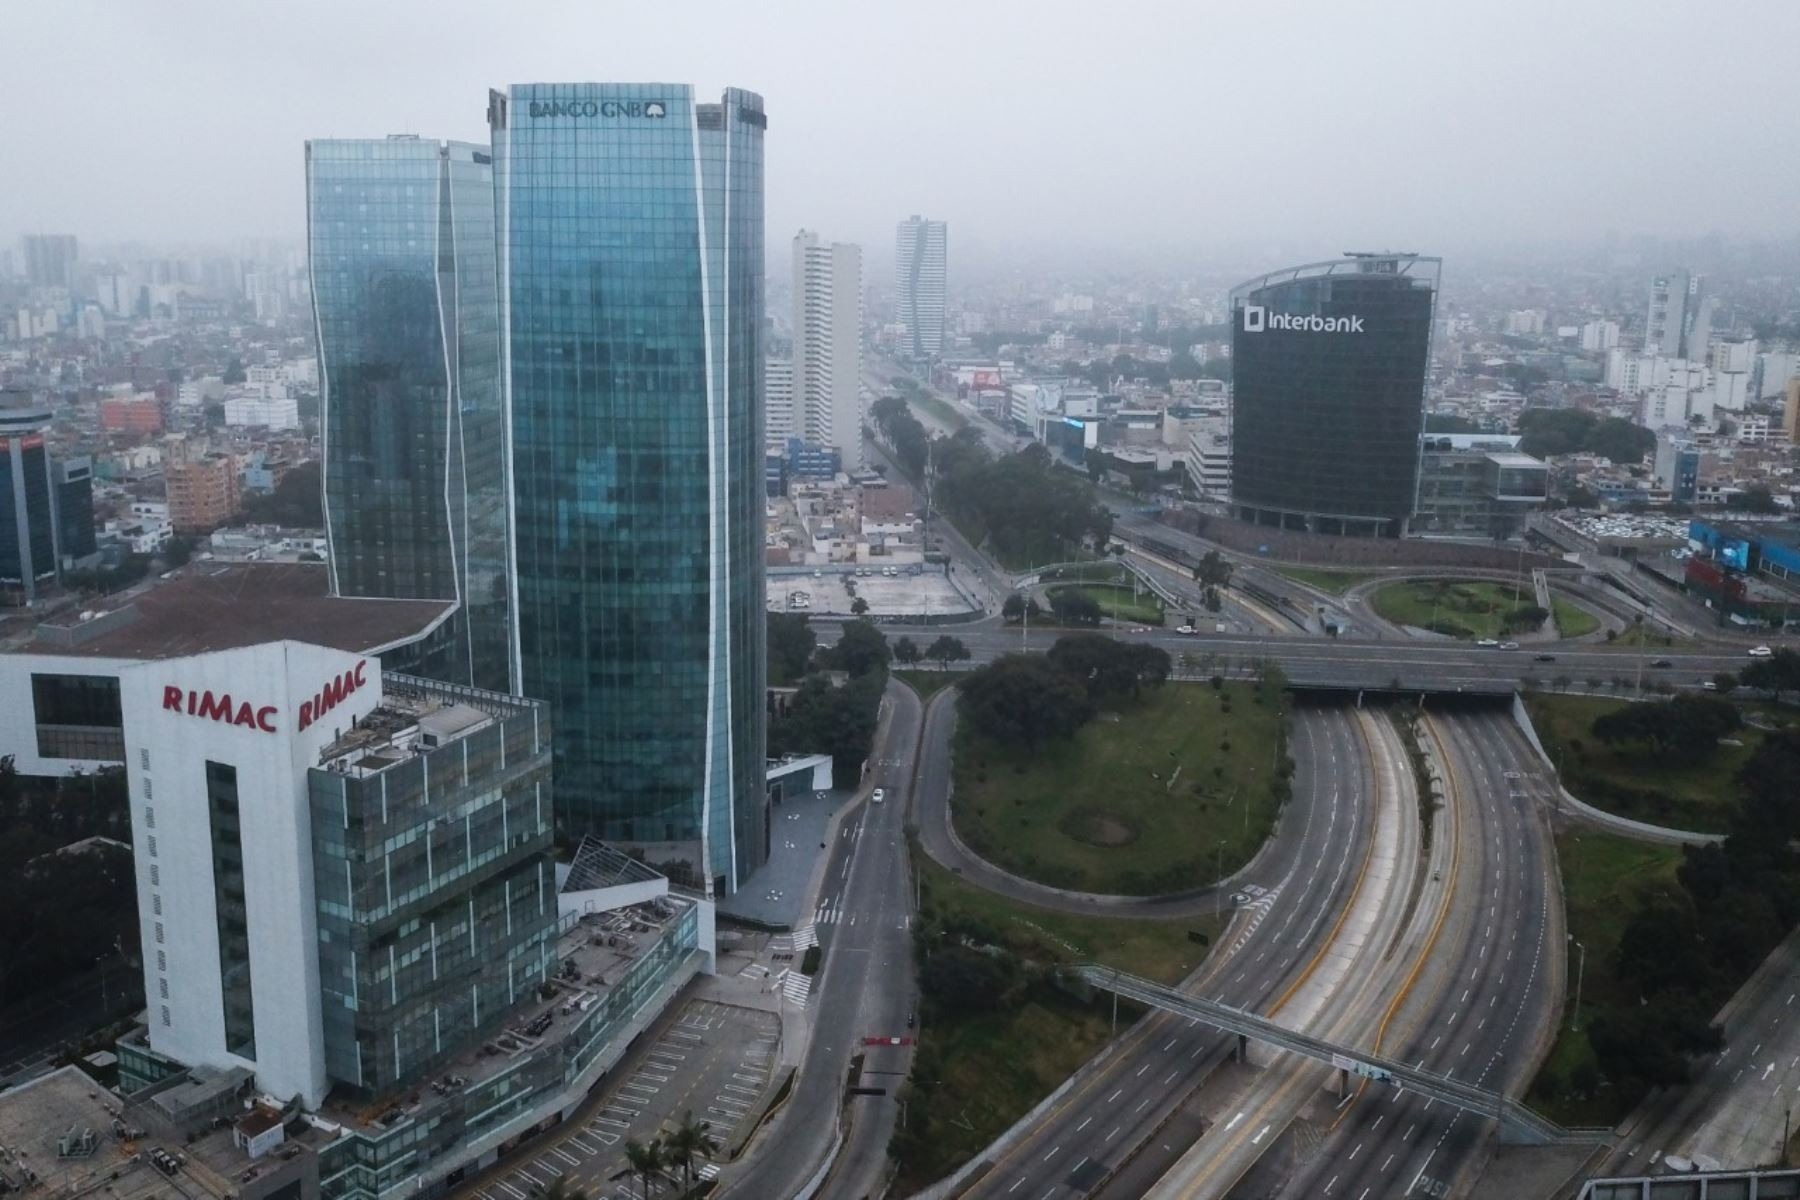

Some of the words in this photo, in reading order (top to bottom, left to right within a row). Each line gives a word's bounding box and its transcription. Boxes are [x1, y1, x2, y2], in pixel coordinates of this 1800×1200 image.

[529, 102, 598, 118] BANCO
[601, 102, 641, 118] GNB
[1269, 311, 1364, 333] Interbank
[163, 685, 277, 733] RIMAC
[299, 659, 366, 732] RIMAC
